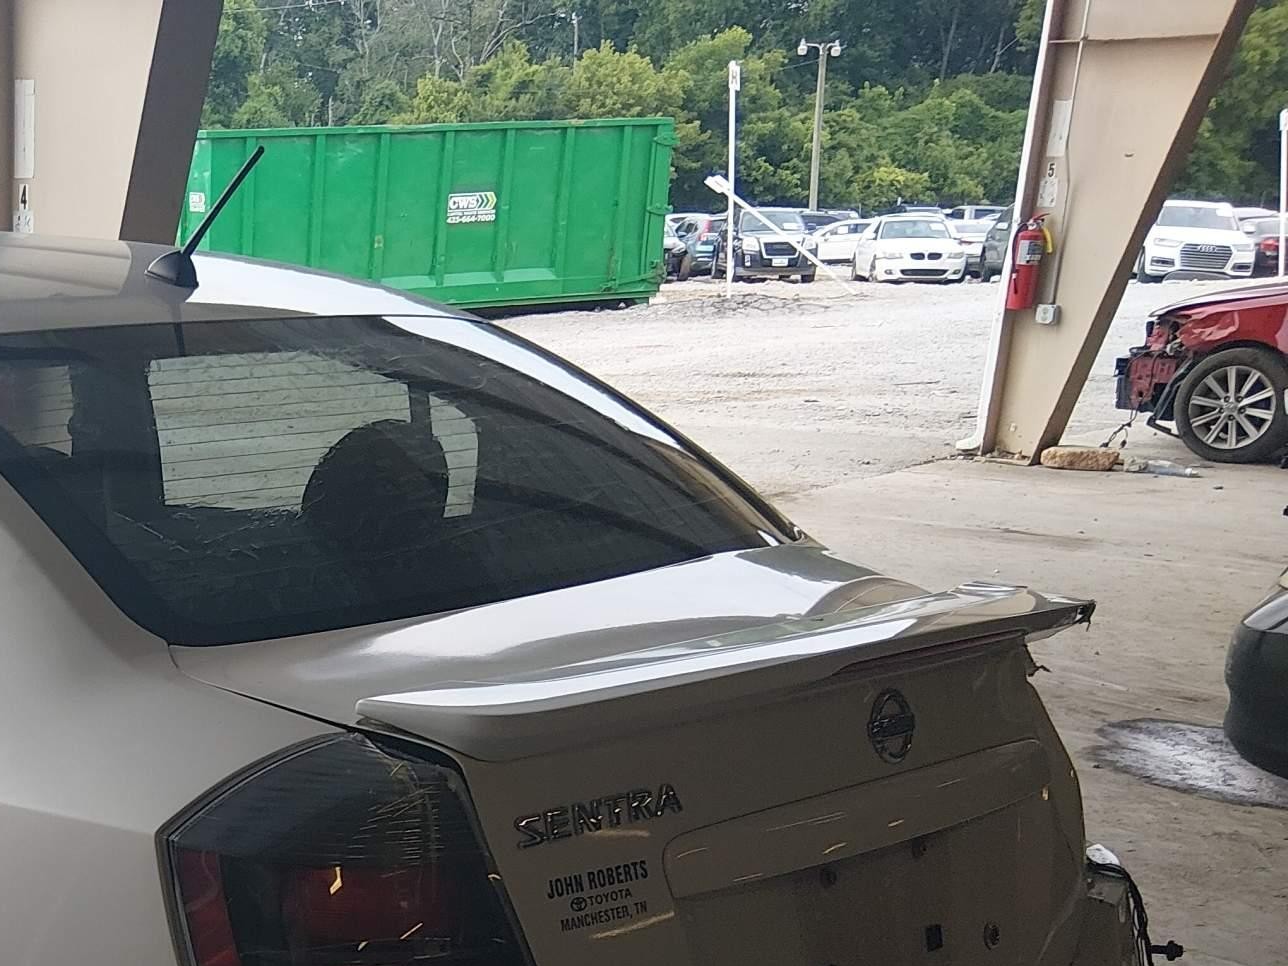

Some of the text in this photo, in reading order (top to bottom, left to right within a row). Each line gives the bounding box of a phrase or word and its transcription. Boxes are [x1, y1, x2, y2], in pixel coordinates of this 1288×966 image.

[1047, 163, 1055, 177] 5
[20, 184, 28, 210] 4
[449, 196, 477, 209] CWS
[514, 783, 683, 848] SENTRA
[547, 860, 648, 899] JOHN ROBERTS
[588, 888, 632, 905] TOYOTA
[561, 901, 648, 932] MANCHESTER, TN
